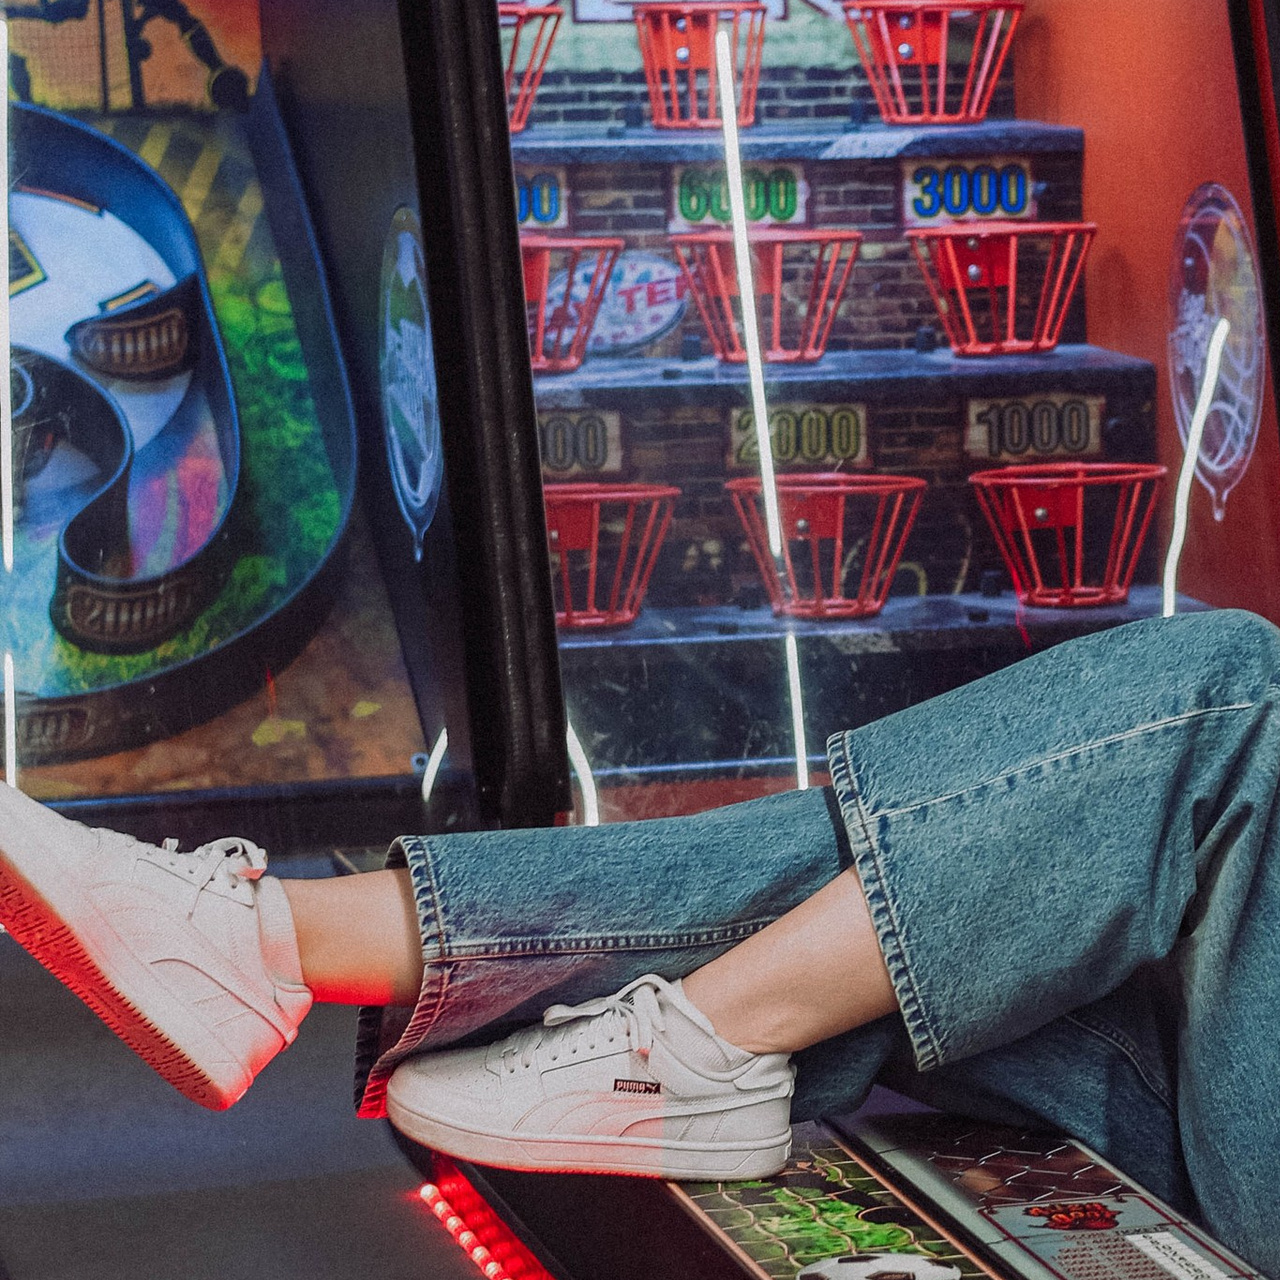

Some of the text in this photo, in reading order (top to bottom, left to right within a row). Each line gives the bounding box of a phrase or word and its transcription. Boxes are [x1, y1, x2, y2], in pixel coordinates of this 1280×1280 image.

[911, 165, 1027, 217] 3000
[736, 407, 860, 463] 2000
[975, 399, 1092, 454] 1000
[616, 1081, 646, 1091] PUMA
